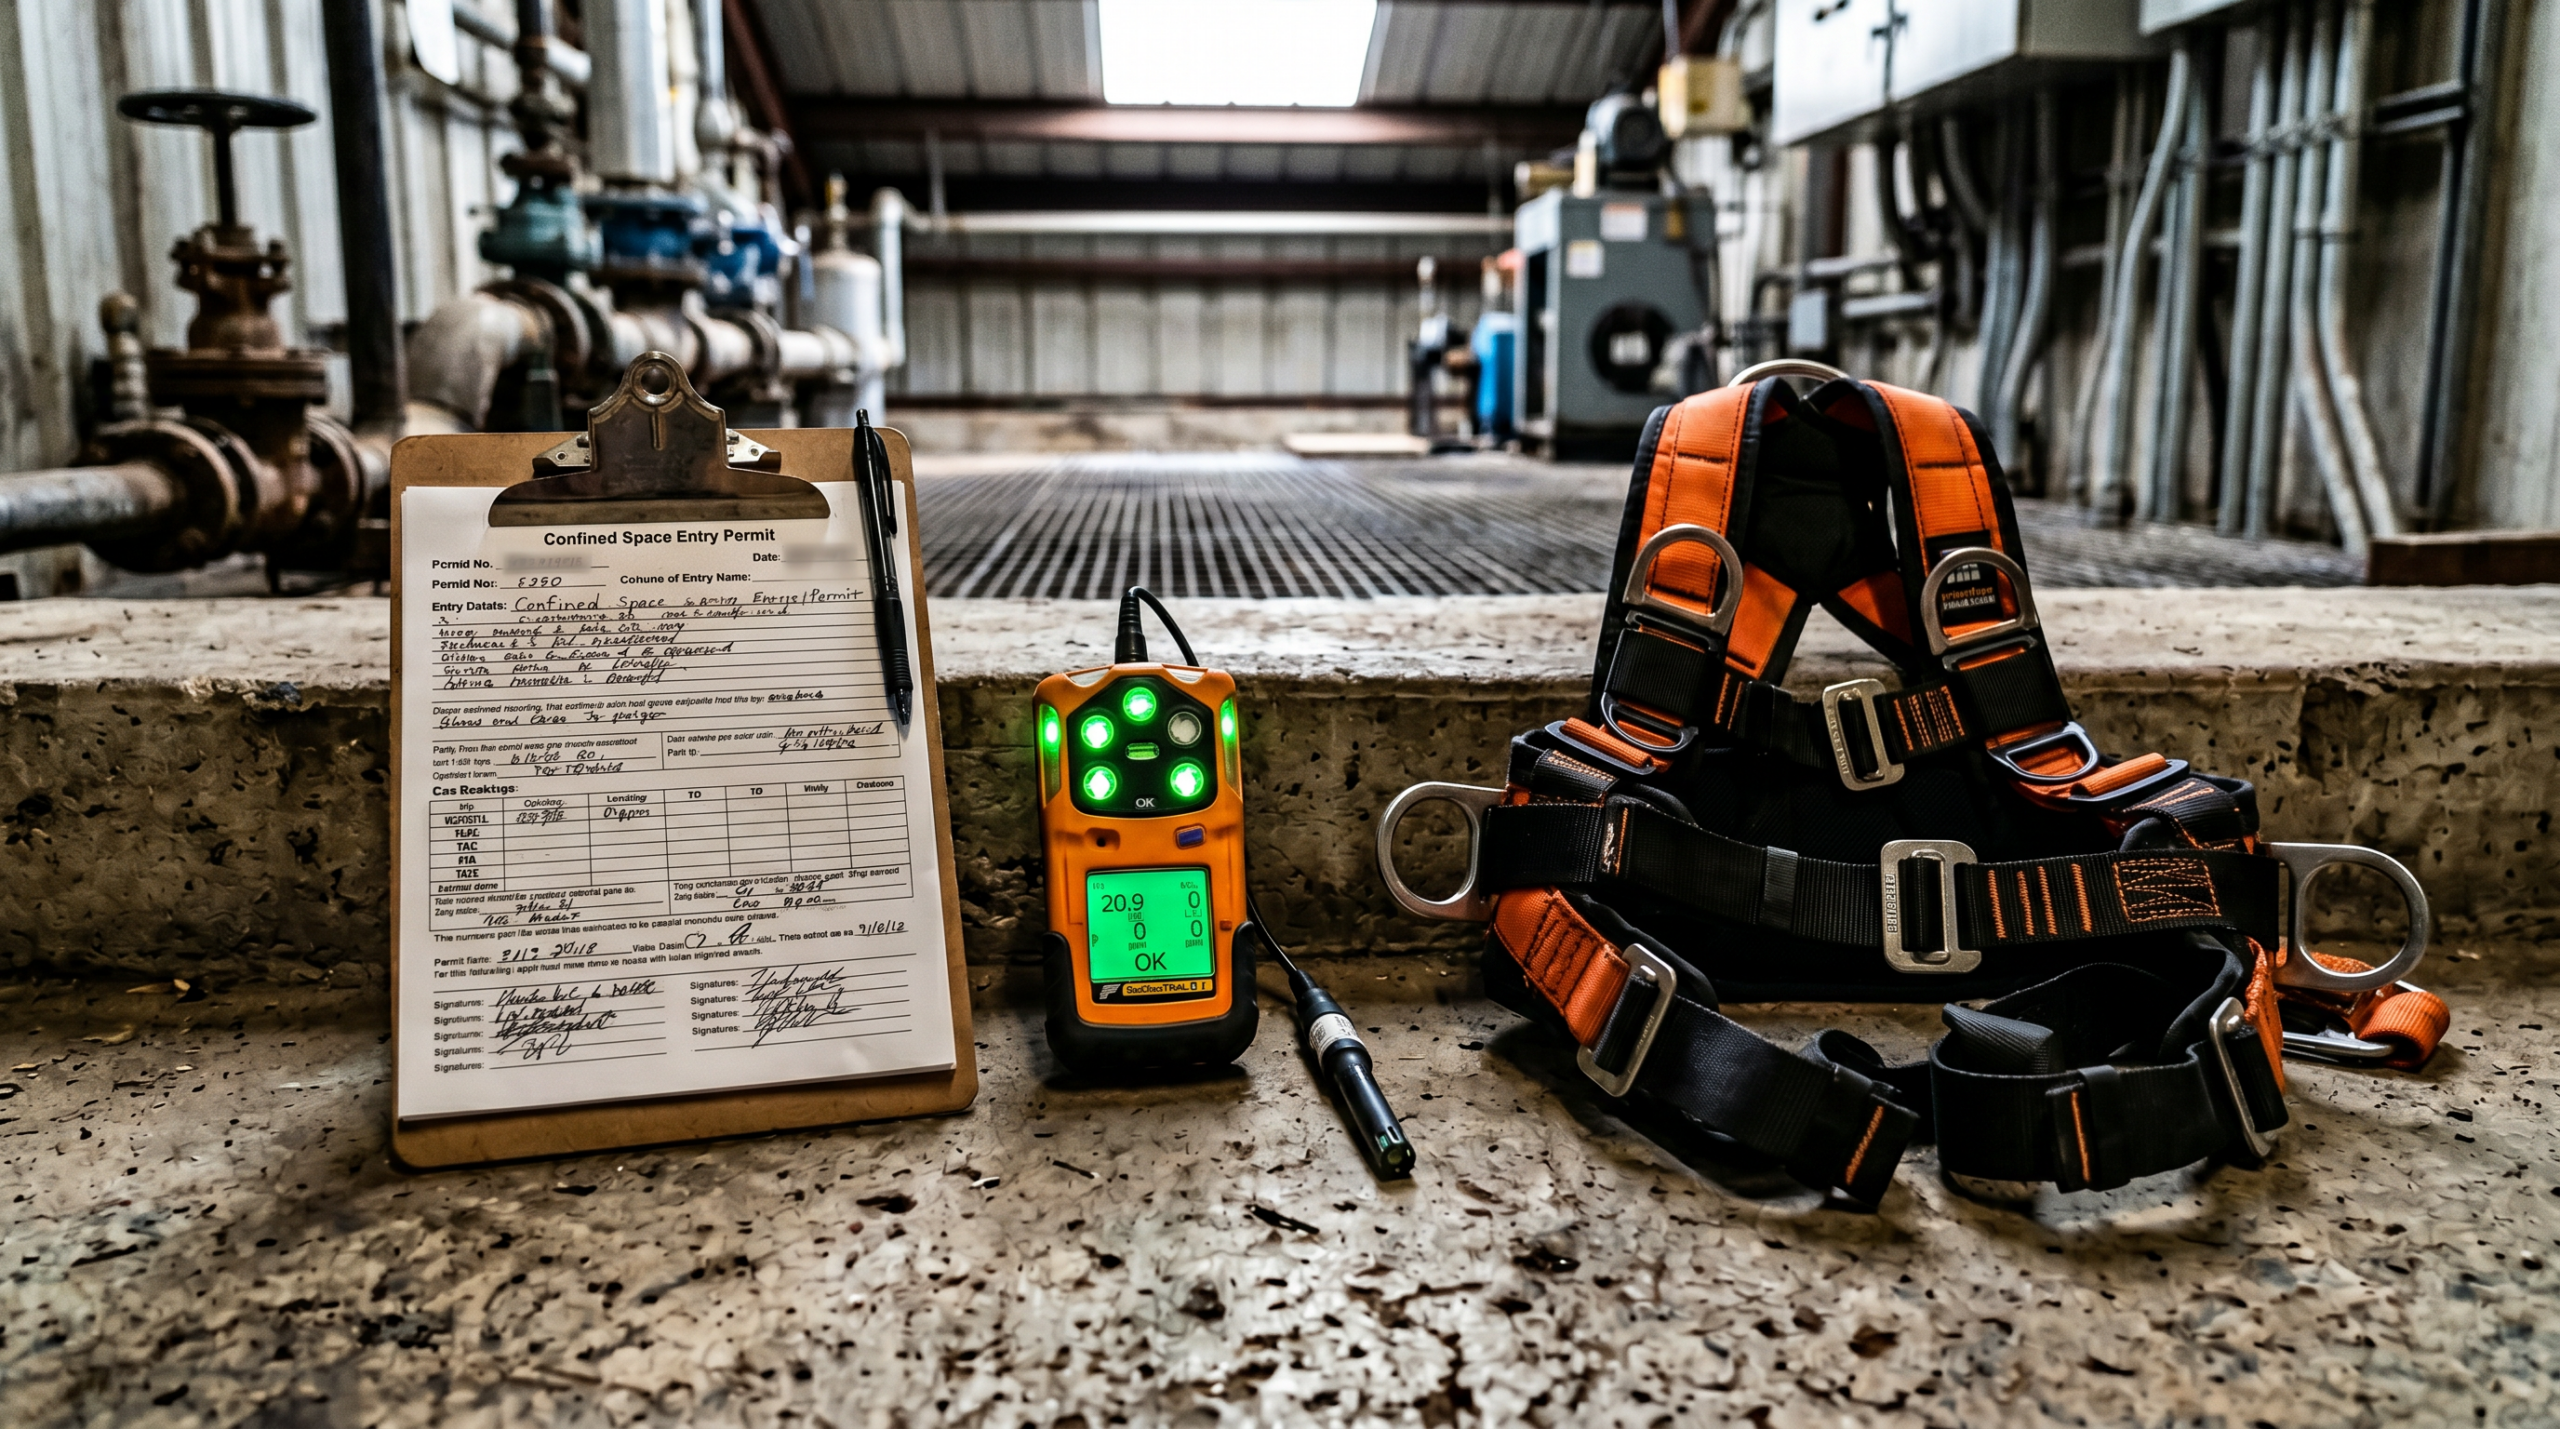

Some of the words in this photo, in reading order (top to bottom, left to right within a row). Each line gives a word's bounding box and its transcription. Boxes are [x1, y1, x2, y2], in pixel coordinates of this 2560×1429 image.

[544, 532, 617, 546] Confined
[622, 530, 672, 547] Space
[676, 530, 719, 545] Entry
[723, 528, 776, 542] Permit
[753, 552, 781, 562] Date:
[473, 558, 493, 569] No.
[620, 575, 665, 584] Cohune
[667, 573, 680, 583] of
[682, 573, 713, 585] Entry
[716, 572, 751, 582] Name:
[432, 602, 463, 614] Entry
[514, 592, 600, 612] Confined
[616, 595, 666, 615] Space
[432, 786, 457, 797] Cas
[1135, 797, 1156, 808] OK
[456, 841, 478, 851] TAC
[1101, 893, 1145, 913] 20.9
[1188, 890, 1201, 909] 0
[1133, 922, 1147, 941] 0
[1190, 919, 1204, 938] 0
[1134, 952, 1168, 972] OK
[690, 980, 739, 991] Signatures:
[690, 995, 739, 1006] Signatures:
[691, 1010, 740, 1021] Signatures:
[692, 1025, 741, 1037] Signatures:
